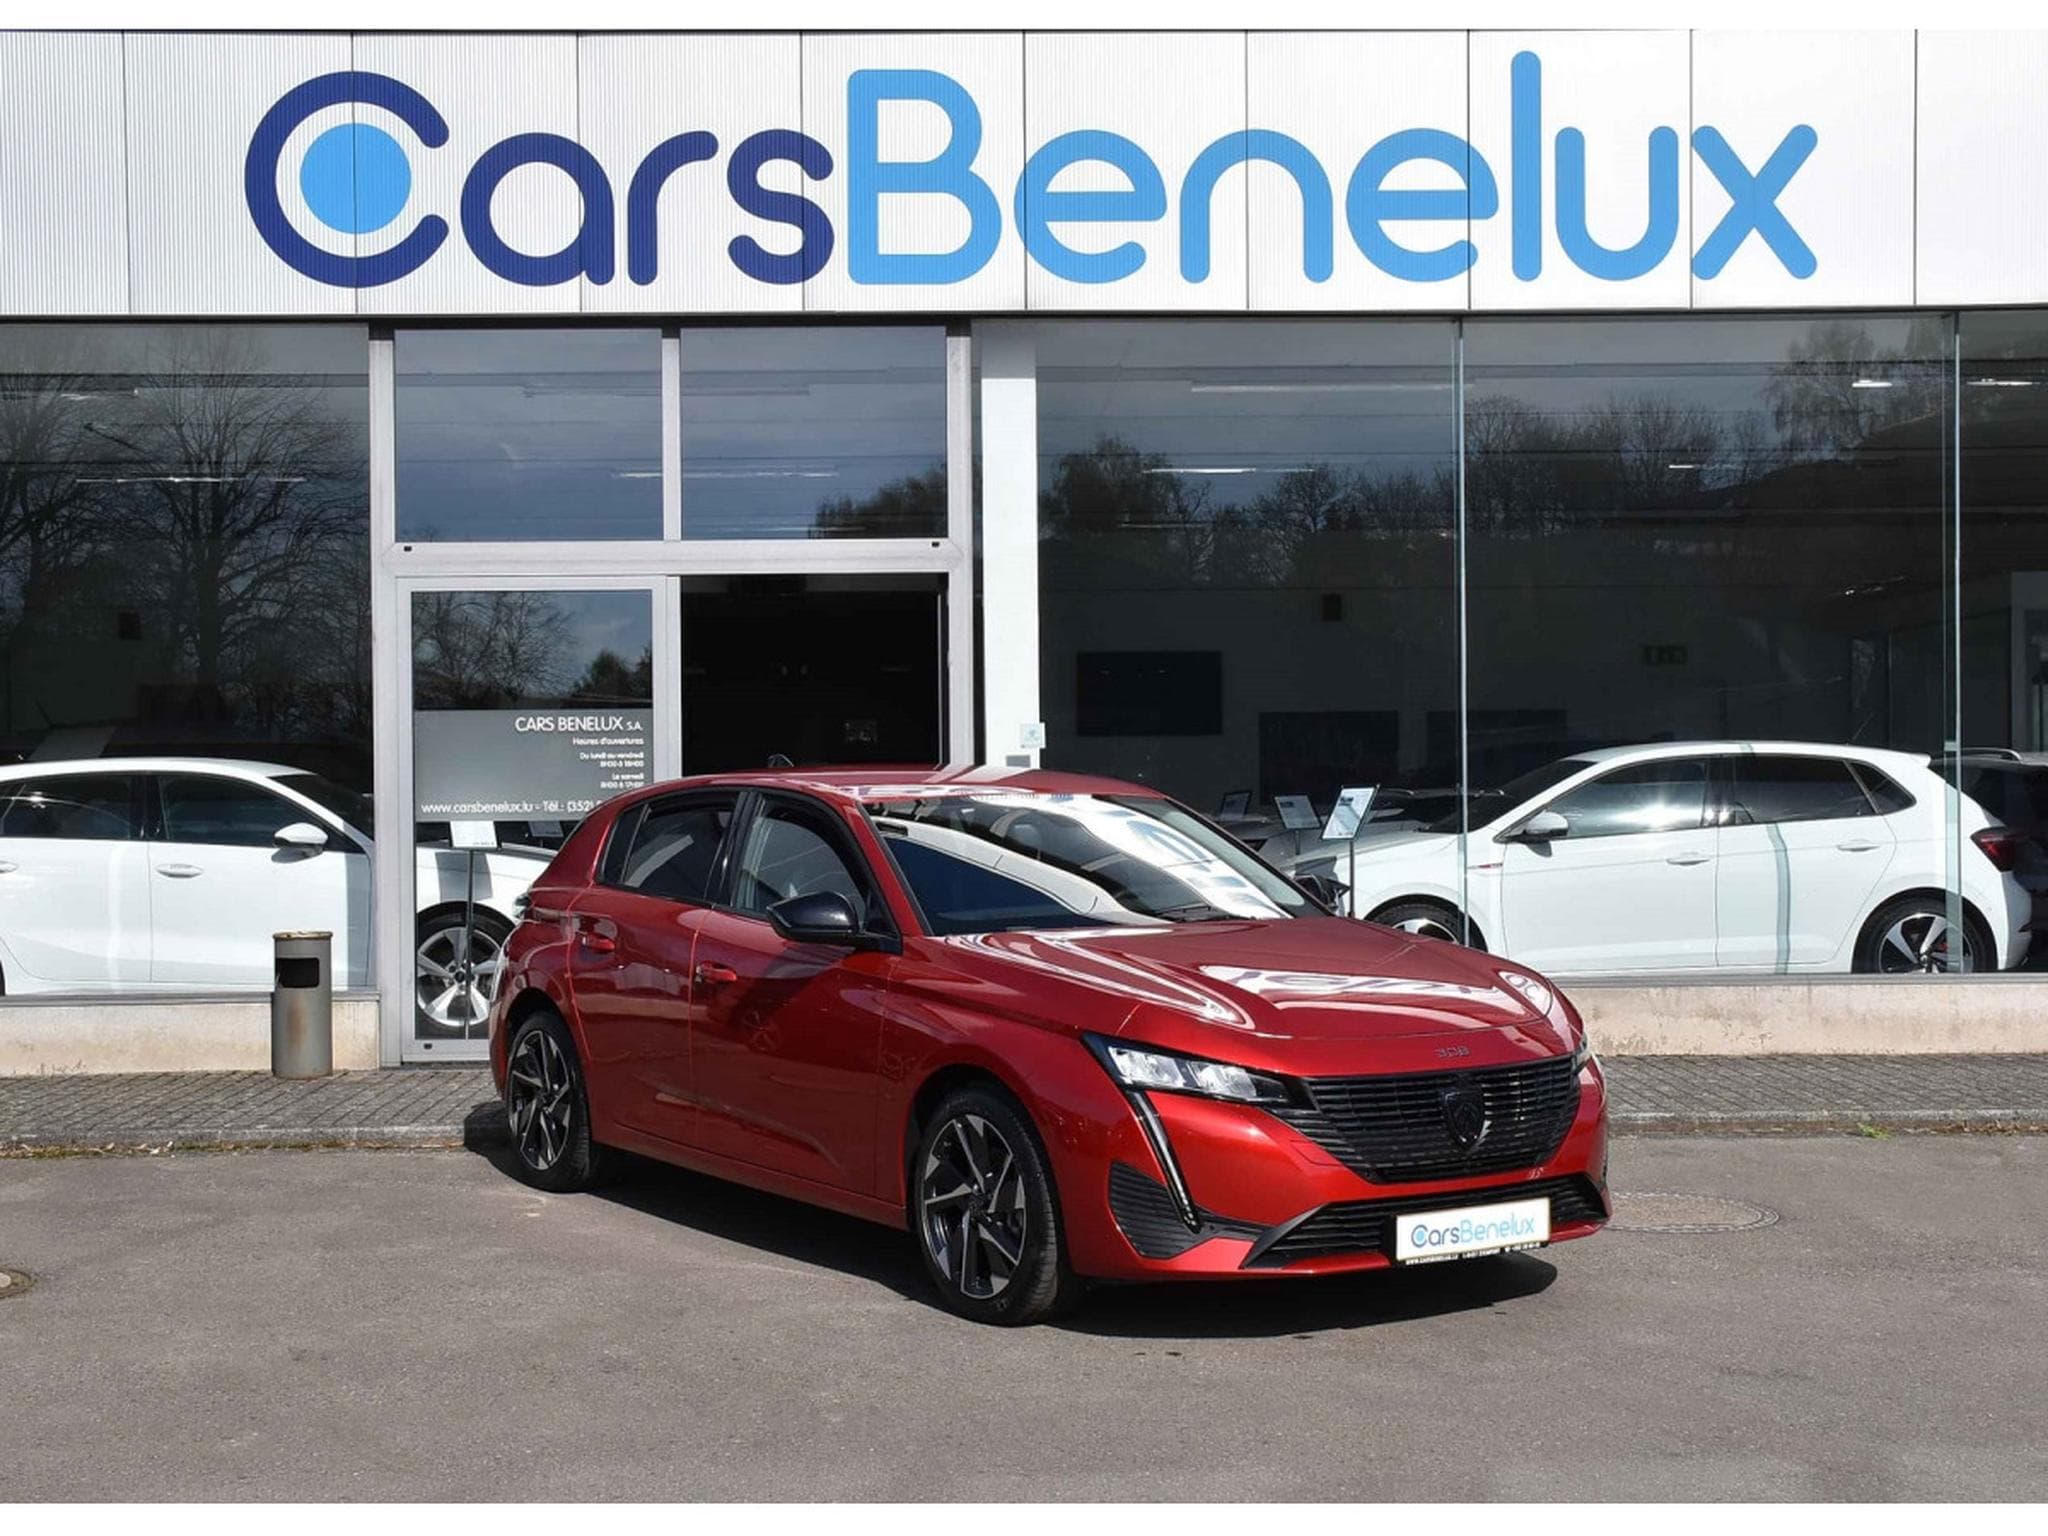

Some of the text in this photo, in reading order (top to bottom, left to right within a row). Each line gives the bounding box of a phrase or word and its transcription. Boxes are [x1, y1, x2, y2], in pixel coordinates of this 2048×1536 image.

[244, 51, 1818, 288] CarsBenelux
[515, 716, 555, 732] CARS
[558, 716, 624, 731] BENELUX
[572, 737, 599, 746] Heures
[421, 801, 533, 814] www.carsbenelux.lu
[1411, 1212, 1535, 1248] CarsBenelux
